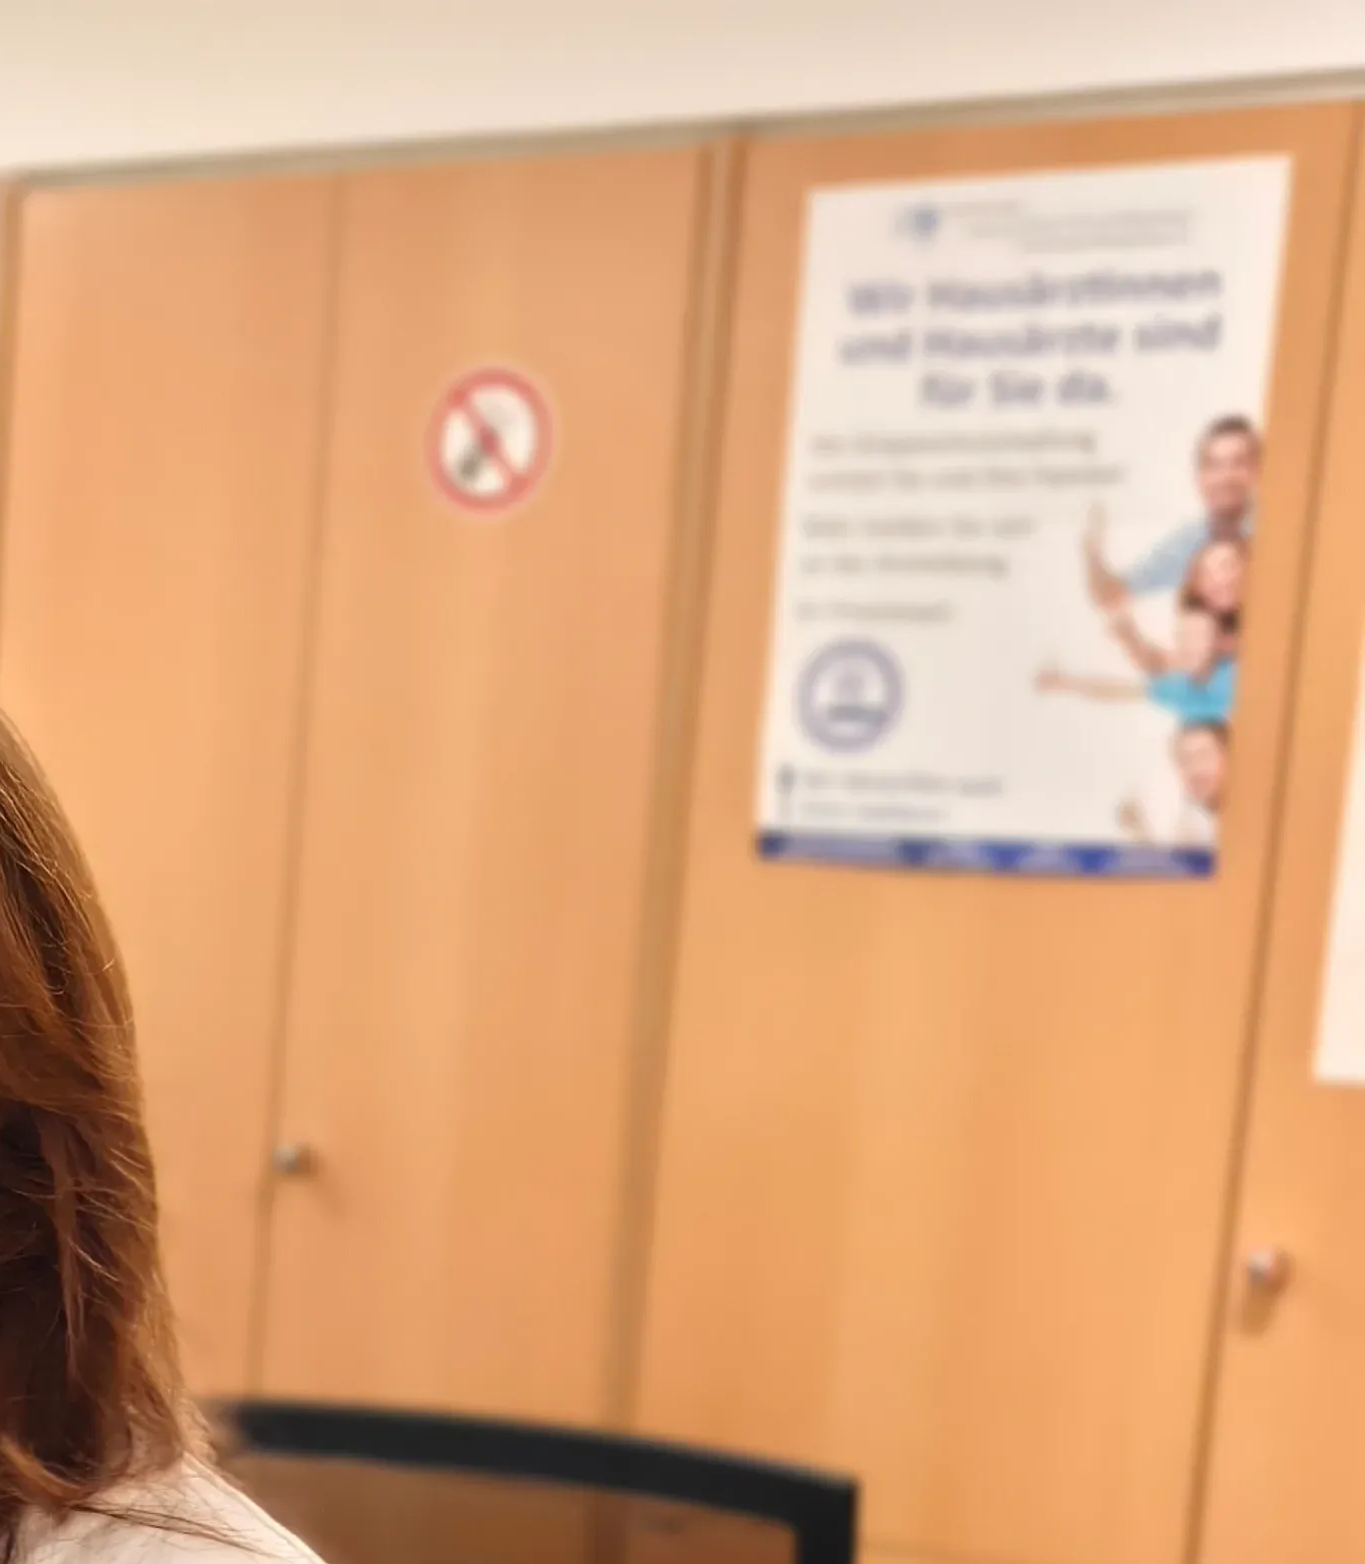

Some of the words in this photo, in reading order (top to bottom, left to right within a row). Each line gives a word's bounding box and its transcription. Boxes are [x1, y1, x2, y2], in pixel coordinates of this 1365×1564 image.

[848, 281, 913, 317] Wir
[840, 330, 911, 366] und
[1134, 313, 1222, 354] sind
[920, 371, 976, 410] für
[988, 370, 1045, 408] Sie
